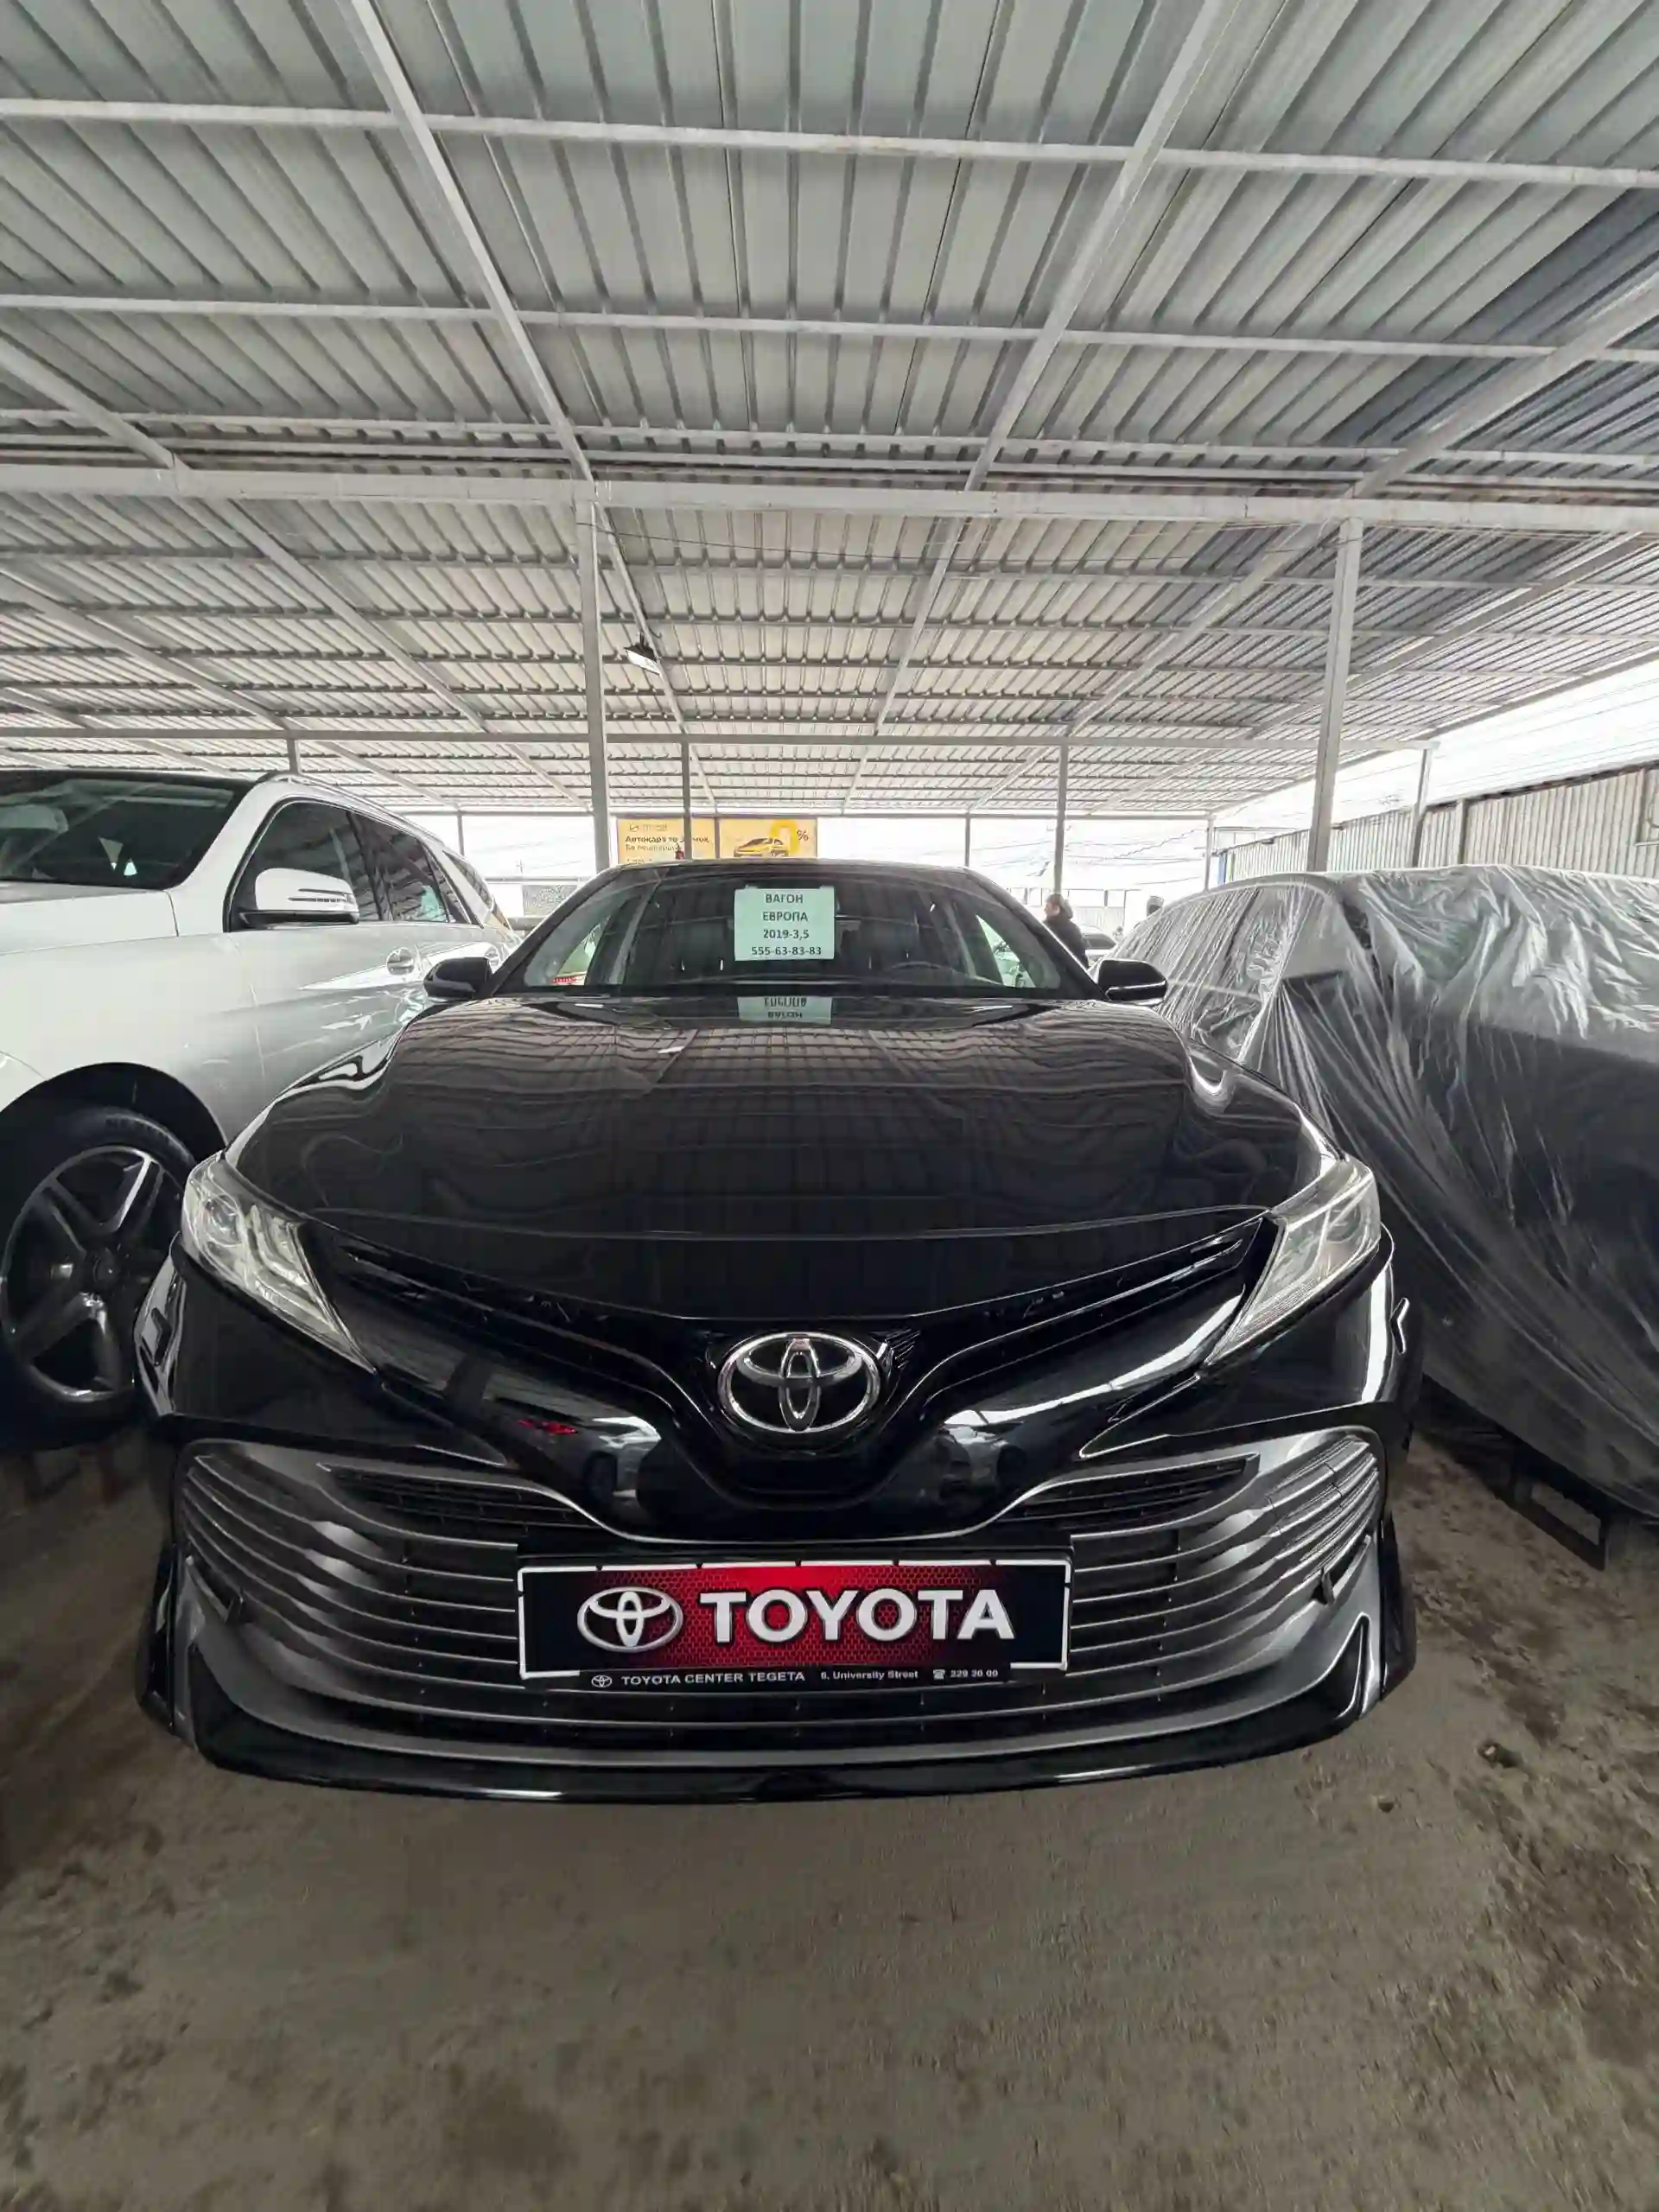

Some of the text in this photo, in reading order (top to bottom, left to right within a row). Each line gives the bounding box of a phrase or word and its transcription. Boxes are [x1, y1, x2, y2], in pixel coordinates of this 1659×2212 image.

[766, 894, 804, 904] ВАГОН
[763, 912, 809, 922] ЕВРОПА
[763, 929, 810, 940] 2019-3,5
[752, 946, 822, 956] 555-63-83-83
[700, 1586, 1015, 1643] TOYOTA
[621, 1675, 681, 1685] TOYOTA
[684, 1673, 744, 1684] CENTER
[748, 1671, 806, 1682] TEGETA
[833, 1669, 885, 1681] University
[887, 1669, 919, 1680] Street
